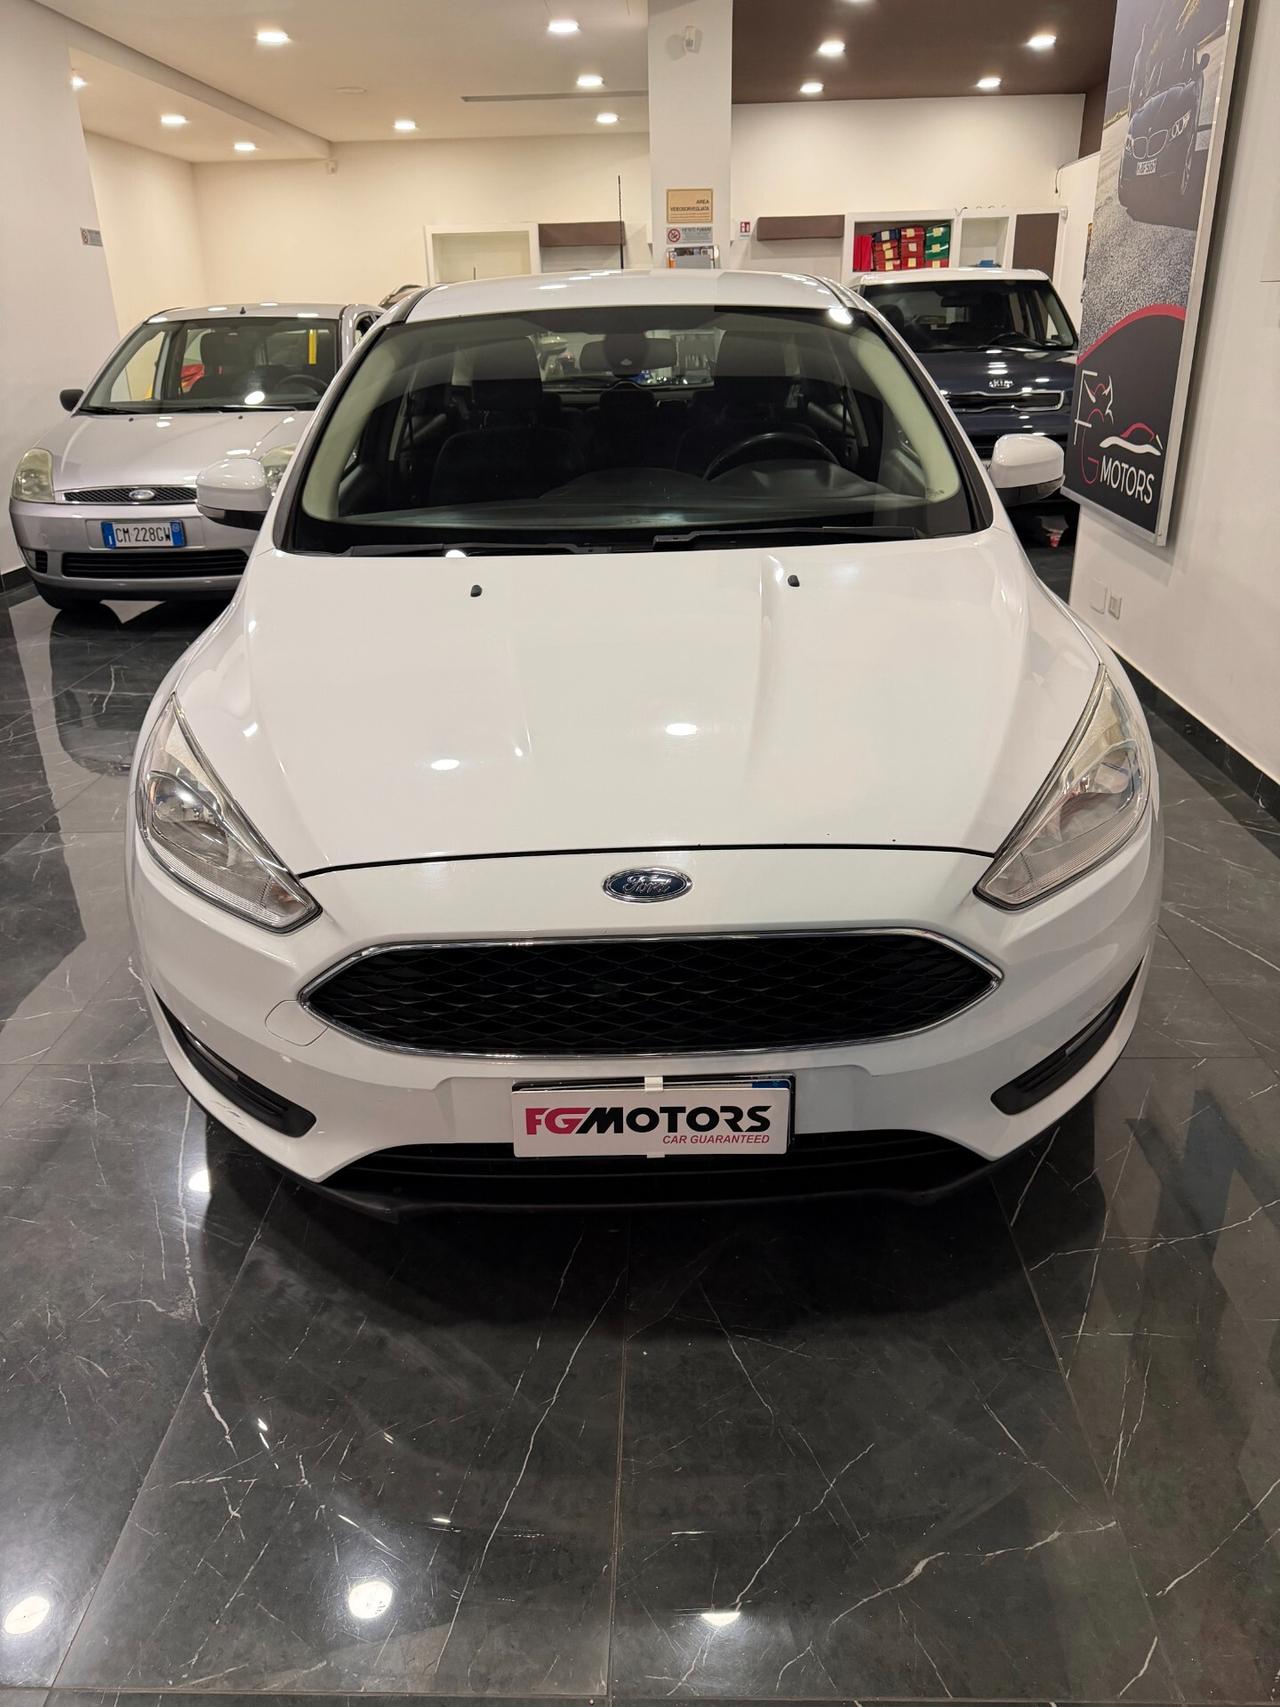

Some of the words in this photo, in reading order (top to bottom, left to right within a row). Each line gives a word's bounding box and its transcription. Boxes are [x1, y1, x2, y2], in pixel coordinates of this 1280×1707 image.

[1099, 455, 1155, 504] MOTORS
[623, 874, 672, 894] Ford
[662, 1134, 688, 1145] CAR
[690, 1134, 770, 1145] GUARANTEED
